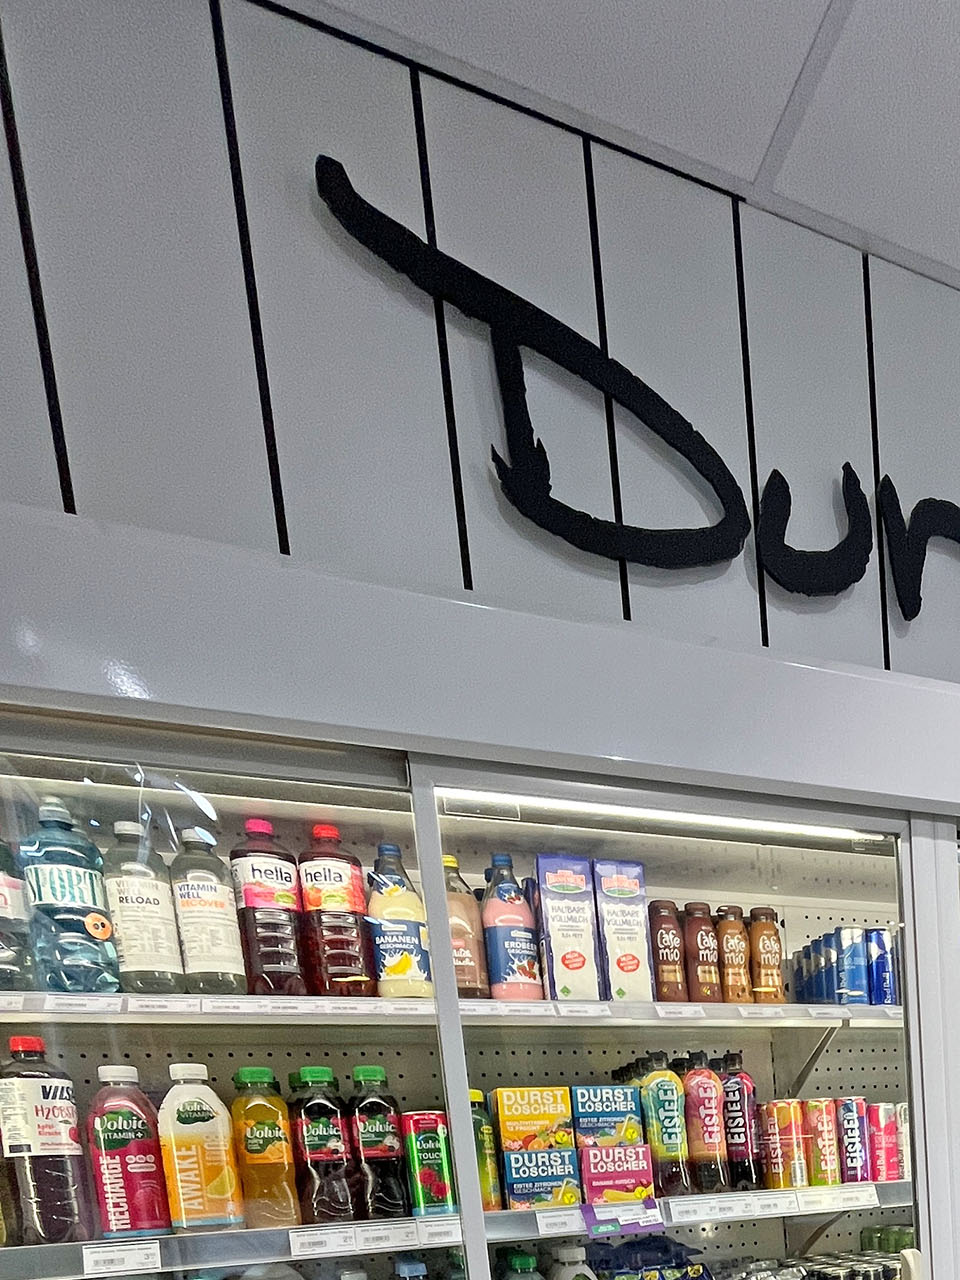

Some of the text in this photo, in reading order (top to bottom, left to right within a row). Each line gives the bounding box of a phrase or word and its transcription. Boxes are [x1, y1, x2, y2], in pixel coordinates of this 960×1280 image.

[251, 863, 293, 883] hella
[304, 866, 343, 883] hella
[178, 884, 217, 892] VITAMIN
[179, 891, 201, 899] WELL
[119, 896, 160, 905] RELOAD
[375, 935, 420, 946] BANANEN
[41, 1085, 76, 1104] VILS
[502, 1090, 564, 1105] DURST
[577, 1088, 635, 1103] DURST
[94, 1116, 146, 1131] Volvic
[304, 1123, 341, 1137] Volvic
[360, 1122, 396, 1135] Volvic
[246, 1126, 287, 1139] Volvic
[510, 1152, 572, 1168] DURST
[589, 1148, 646, 1163] DURST
[181, 1144, 203, 1211] AWAKE
